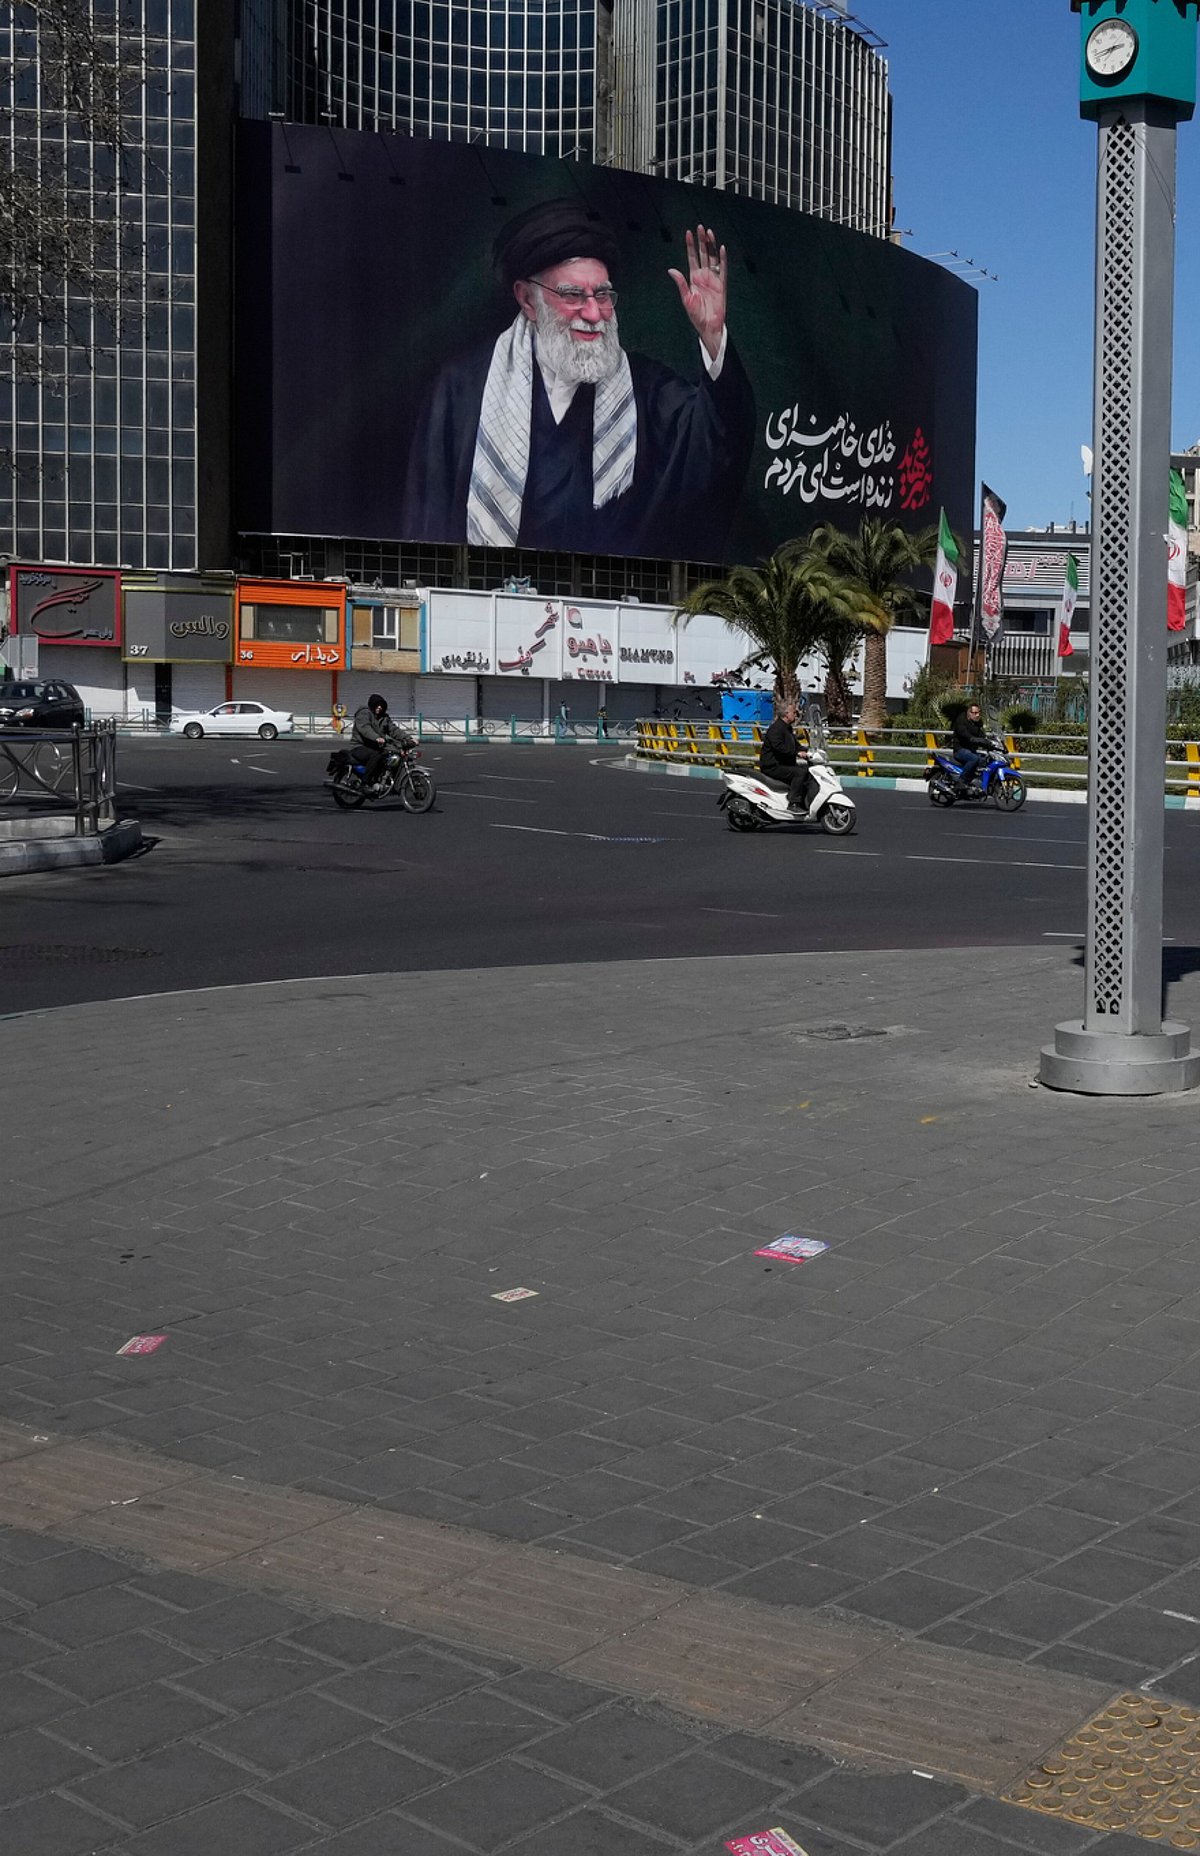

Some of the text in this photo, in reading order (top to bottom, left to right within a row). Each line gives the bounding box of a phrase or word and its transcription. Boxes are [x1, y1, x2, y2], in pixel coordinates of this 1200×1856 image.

[866, 475, 894, 508] زنده
[130, 645, 149, 656] 37
[240, 650, 254, 661] 36
[291, 644, 340, 666] دیدار
